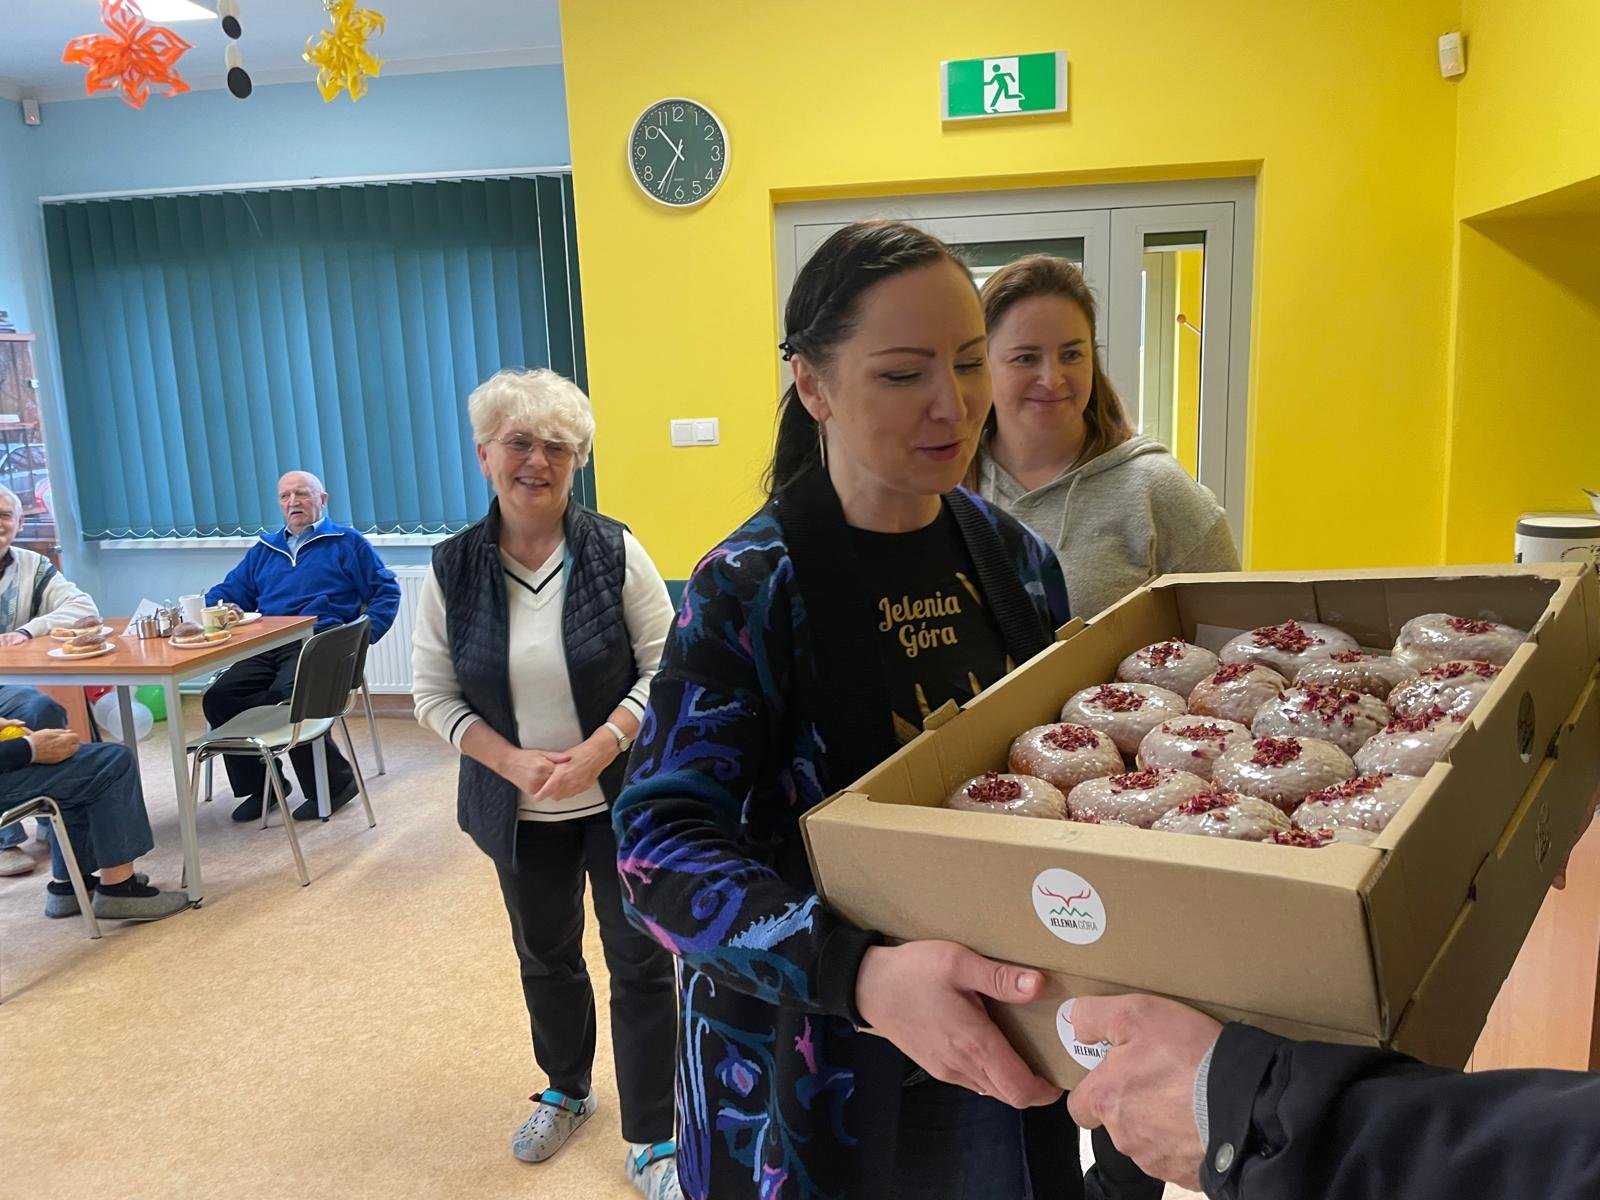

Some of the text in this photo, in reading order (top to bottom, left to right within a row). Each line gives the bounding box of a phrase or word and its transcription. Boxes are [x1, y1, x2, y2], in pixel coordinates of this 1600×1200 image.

[658, 111, 668, 126] 11
[672, 106, 684, 122] 12
[644, 125, 659, 140] 10
[704, 125, 715, 141] 2
[636, 145, 647, 161] 9
[710, 145, 721, 161] 3
[643, 165, 654, 181] 8
[704, 167, 714, 180] 4
[674, 185, 685, 200] 6
[692, 180, 702, 195] 5
[879, 591, 961, 632] Jelenia
[899, 621, 958, 658] Góra
[1050, 917, 1078, 929] JELENIA
[1074, 1044, 1101, 1058] JELENIA
